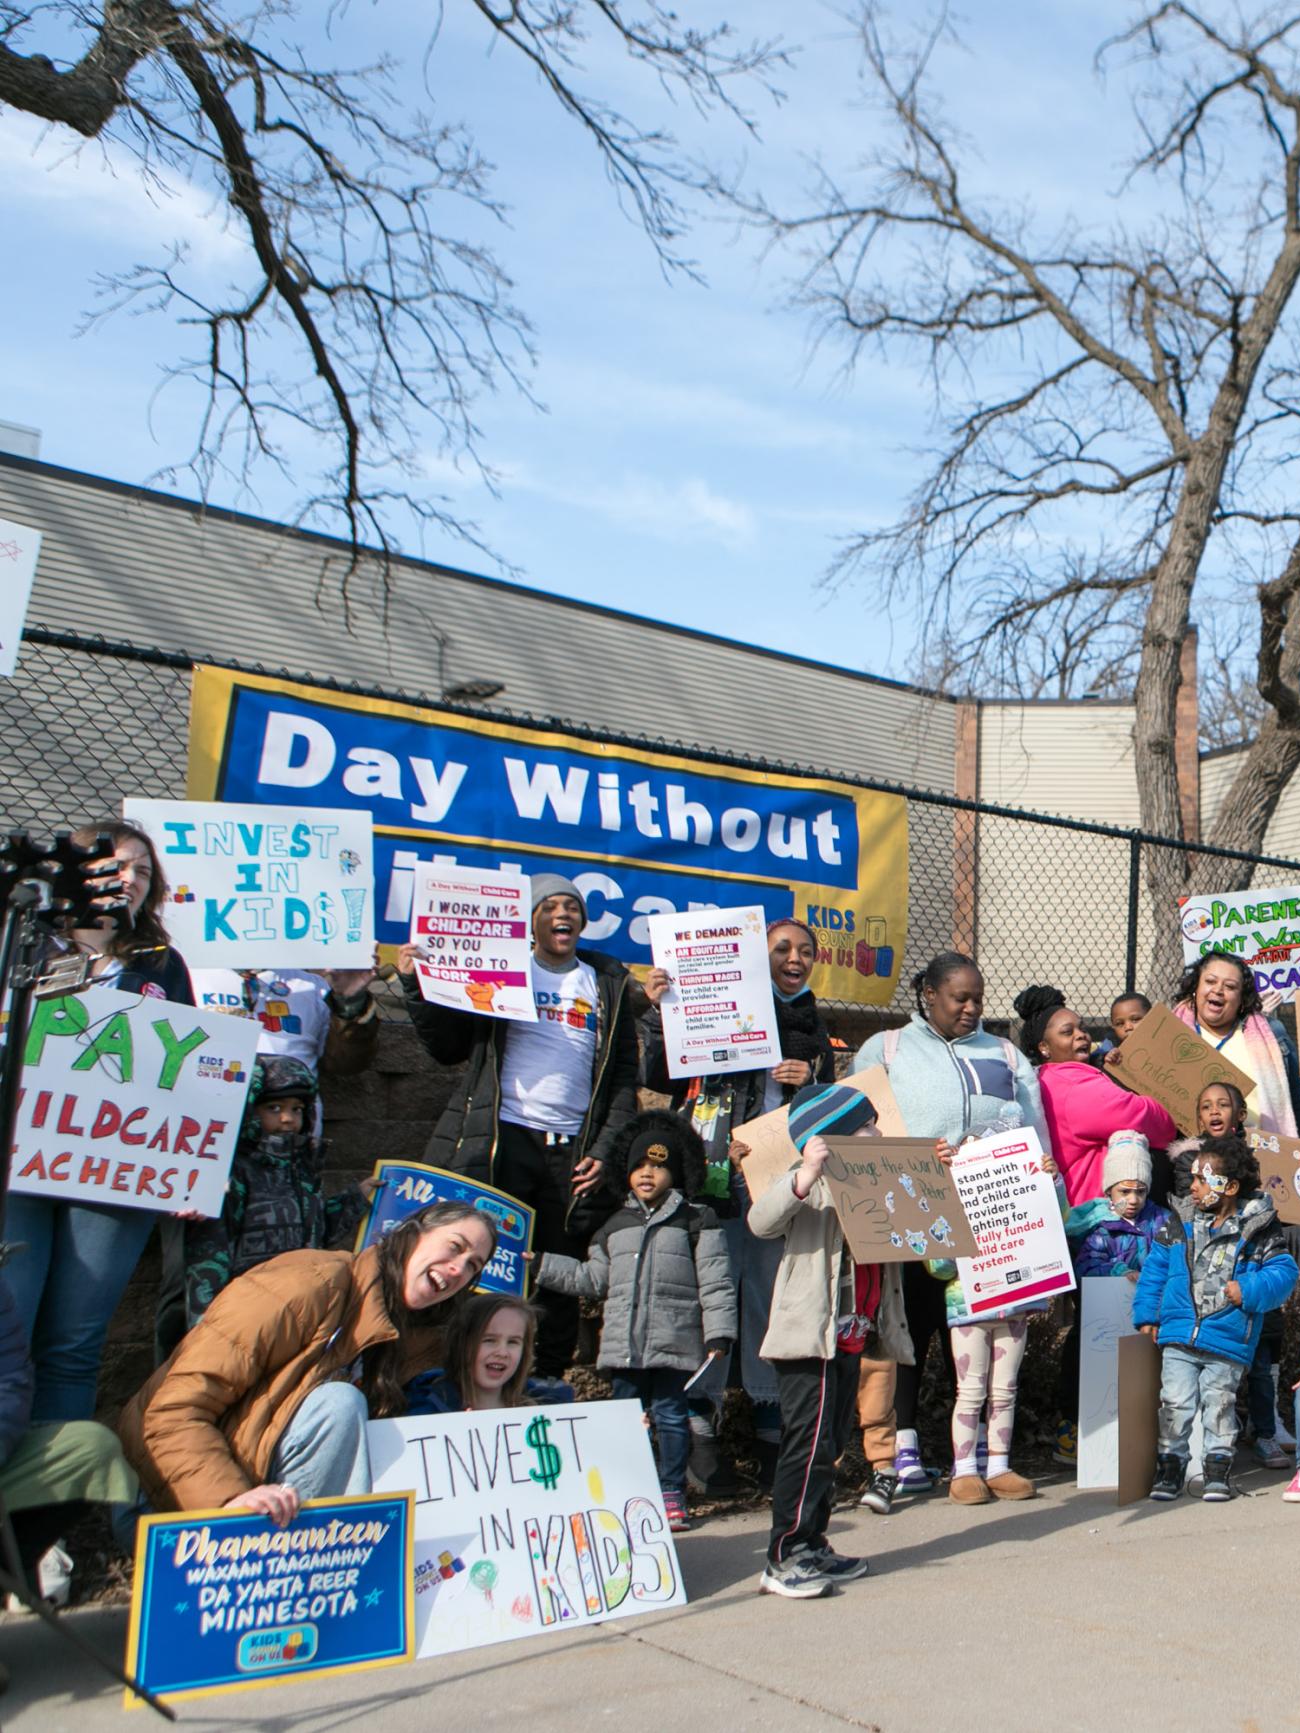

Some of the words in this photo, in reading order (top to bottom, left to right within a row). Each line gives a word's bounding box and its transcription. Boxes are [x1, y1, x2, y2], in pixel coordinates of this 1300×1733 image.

[258, 711, 468, 823] Day
[505, 758, 841, 866] Without
[235, 863, 299, 893] IN
[440, 901, 481, 916] WORK
[486, 905, 500, 918] IN
[572, 872, 722, 945] Ca
[807, 904, 855, 932] KIDS
[427, 917, 512, 937] CHILDCARE
[675, 931, 691, 941] WE
[696, 927, 743, 938] DEMAND:
[428, 937, 445, 949] SO
[453, 939, 481, 951] YOU
[815, 929, 854, 949] OUNT
[677, 948, 689, 956] AN
[691, 944, 734, 955] EQUITABLE
[837, 949, 853, 968] US
[427, 953, 458, 967] CAN
[465, 956, 483, 968] GO
[490, 958, 508, 970] TO
[429, 967, 475, 983] WORK.
[687, 1003, 733, 1014] AFFORDABLE
[686, 1016, 702, 1024] child
[23, 994, 210, 1091] PAY
[199, 1056, 224, 1066] KIDS
[15, 1088, 228, 1161] ILDCARE
[10, 1145, 199, 1201] ACHERS!
[881, 1156, 903, 1174] the
[958, 1168, 990, 1184] stand
[993, 1162, 1018, 1175] with
[396, 1176, 435, 1203] All
[977, 1176, 1020, 1194] parents
[965, 1194, 981, 1208] nd
[982, 1188, 1010, 1204] child
[1013, 1184, 1037, 1196] care
[969, 1202, 1016, 1220] roviders
[973, 1217, 1010, 1234] ghting
[1012, 1211, 1028, 1221] for
[977, 1231, 1001, 1244] fully
[1005, 1218, 1044, 1236] funded
[1001, 1238, 1024, 1250] care
[972, 1254, 1017, 1272] system.
[480, 1508, 515, 1553] IN
[174, 1519, 389, 1567] Dhamaanteen
[524, 1496, 678, 1626] KIDS
[187, 1560, 263, 1584] WAXAAN
[199, 1584, 231, 1609] DA
[236, 1575, 304, 1606] YARTA
[308, 1569, 359, 1593] REER
[200, 1590, 358, 1636] MINNESOTA
[251, 1633, 281, 1647] KIDS
